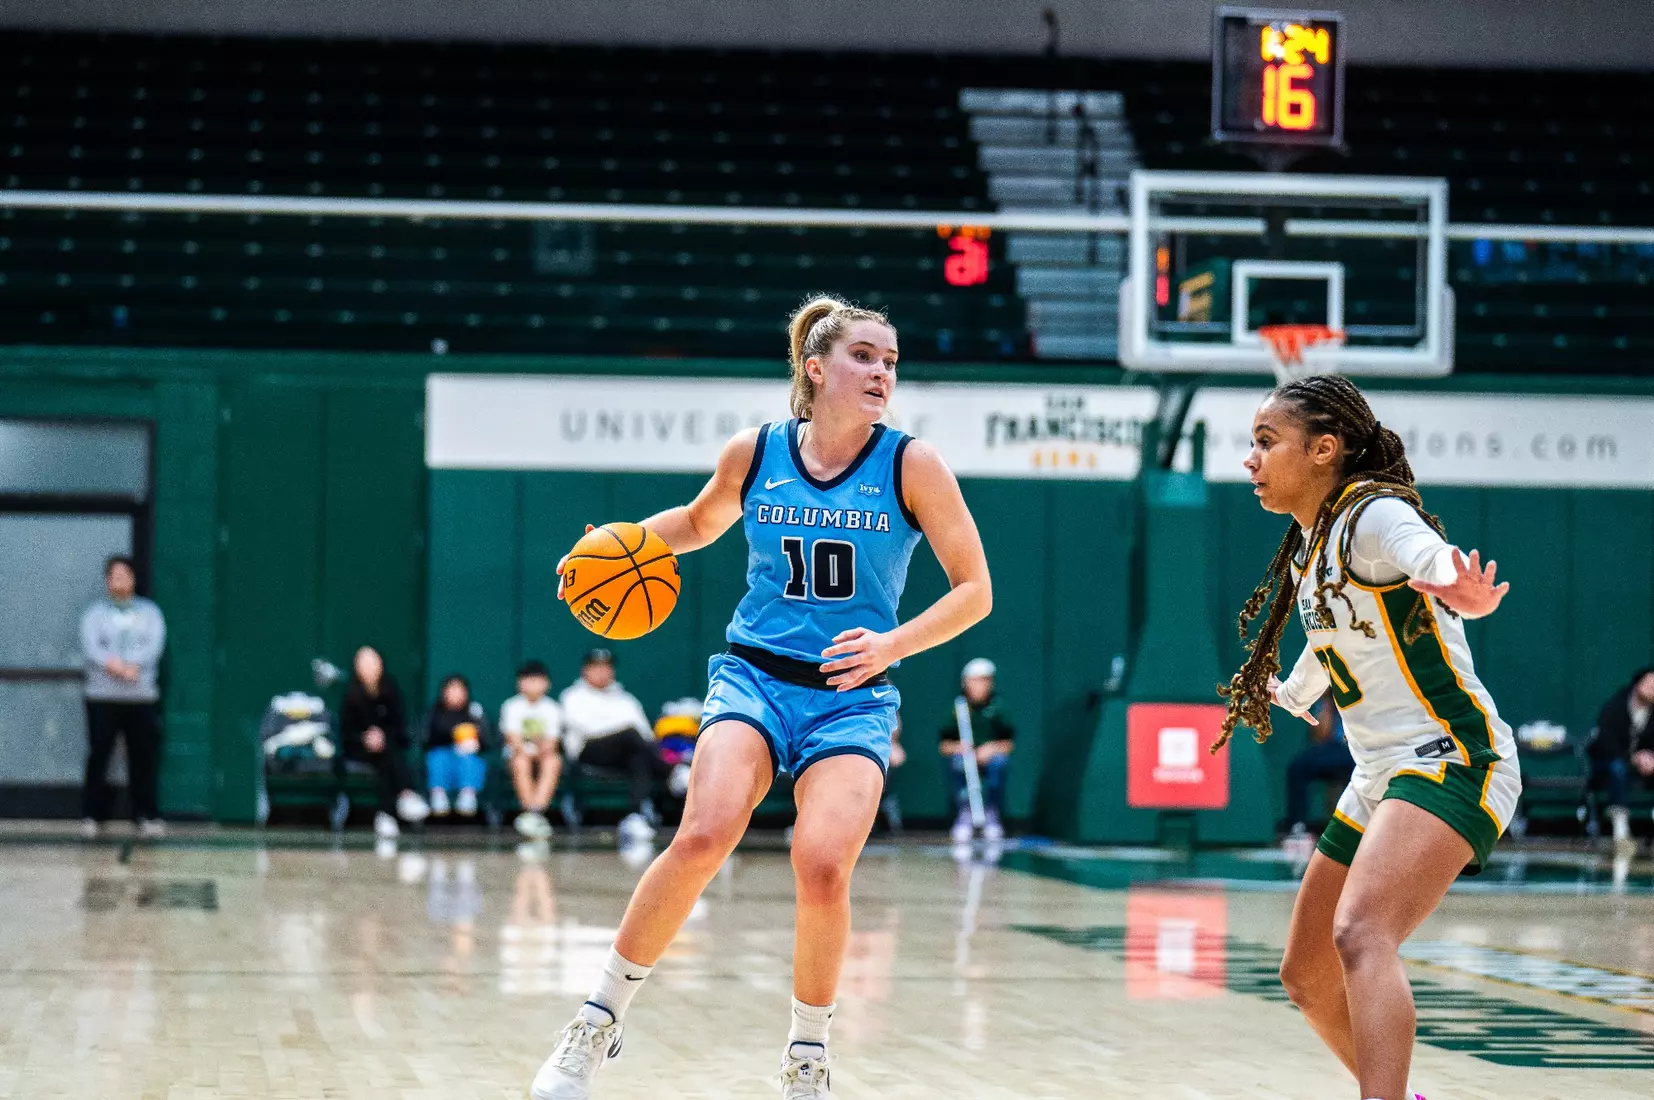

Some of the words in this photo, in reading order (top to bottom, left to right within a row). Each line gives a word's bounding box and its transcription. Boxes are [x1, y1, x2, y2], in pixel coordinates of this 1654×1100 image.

[1261, 62, 1316, 131] 16
[757, 503, 890, 533] COLUMBIA
[780, 534, 857, 602] 10
